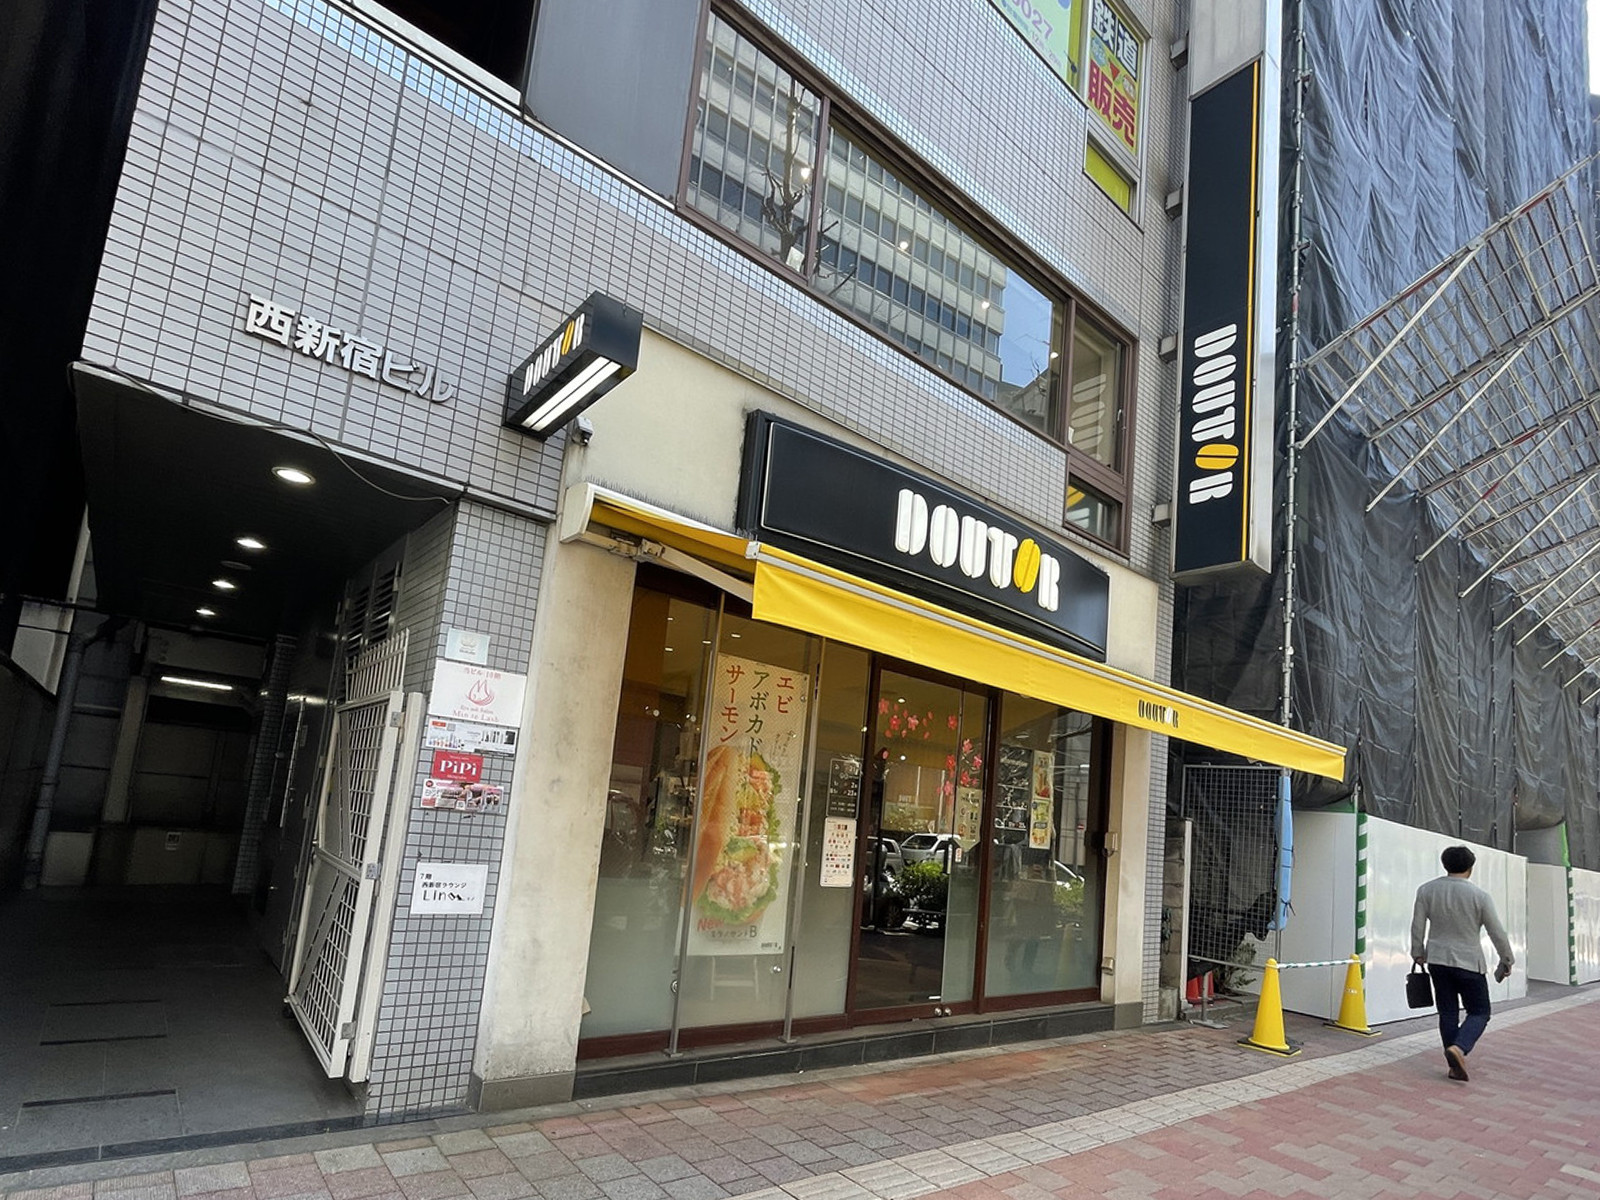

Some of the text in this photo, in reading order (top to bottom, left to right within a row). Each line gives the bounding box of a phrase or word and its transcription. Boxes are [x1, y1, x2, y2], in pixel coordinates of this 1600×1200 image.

[1088, 58, 1136, 148] 販売
[245, 293, 455, 404] 西新宿ビル
[523, 313, 586, 396] DOUTOR
[1189, 323, 1240, 505] DOUTOR
[894, 488, 1061, 612] DOUTOR
[720, 665, 745, 742] サーモン
[745, 670, 770, 758] アボカド
[776, 676, 795, 714] エビ
[1138, 699, 1179, 729] DOUTOR
[440, 760, 477, 776] PiPi
